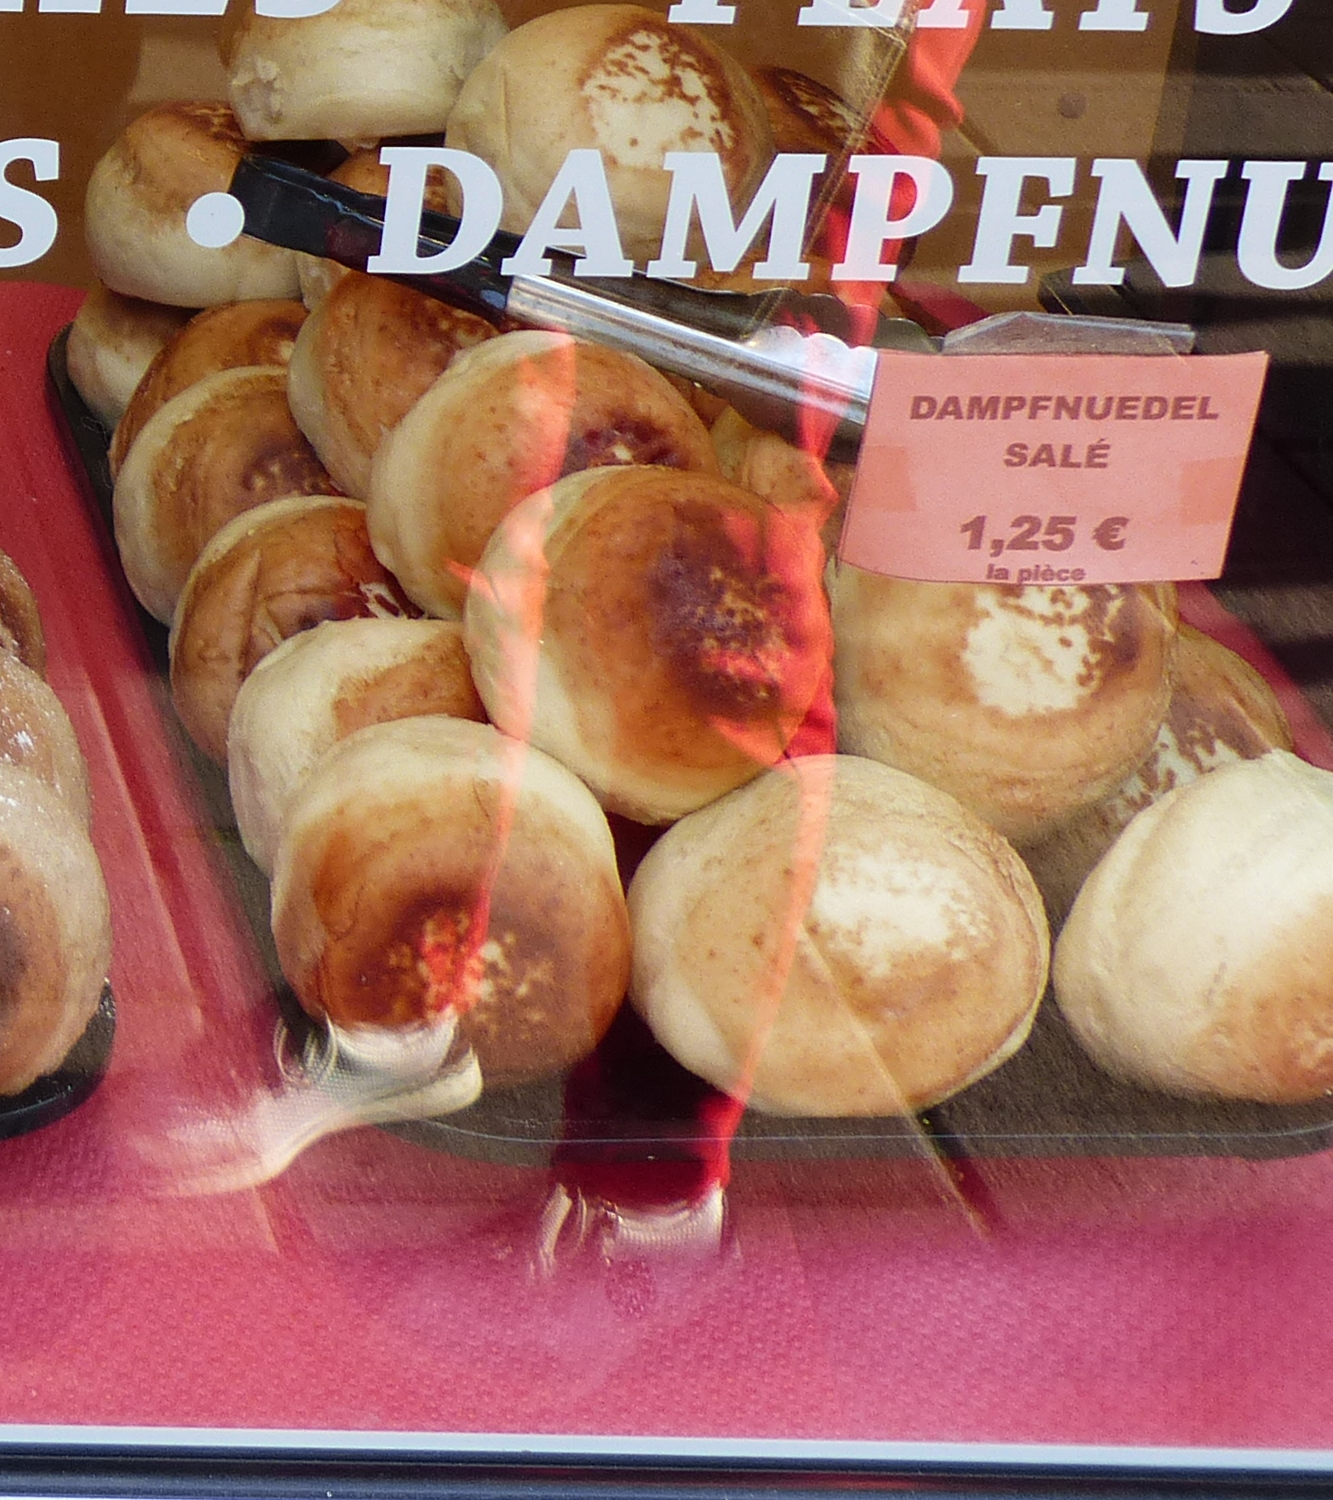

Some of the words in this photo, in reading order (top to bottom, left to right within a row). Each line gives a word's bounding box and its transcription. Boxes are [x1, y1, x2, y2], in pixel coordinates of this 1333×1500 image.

[909, 394, 1220, 421] DAMPFNUEDEL
[1003, 438, 1112, 469] SALÉ
[959, 514, 1079, 558] 1,25
[1091, 516, 1131, 551] €
[986, 563, 1009, 581] la
[1016, 563, 1087, 583] pièce
